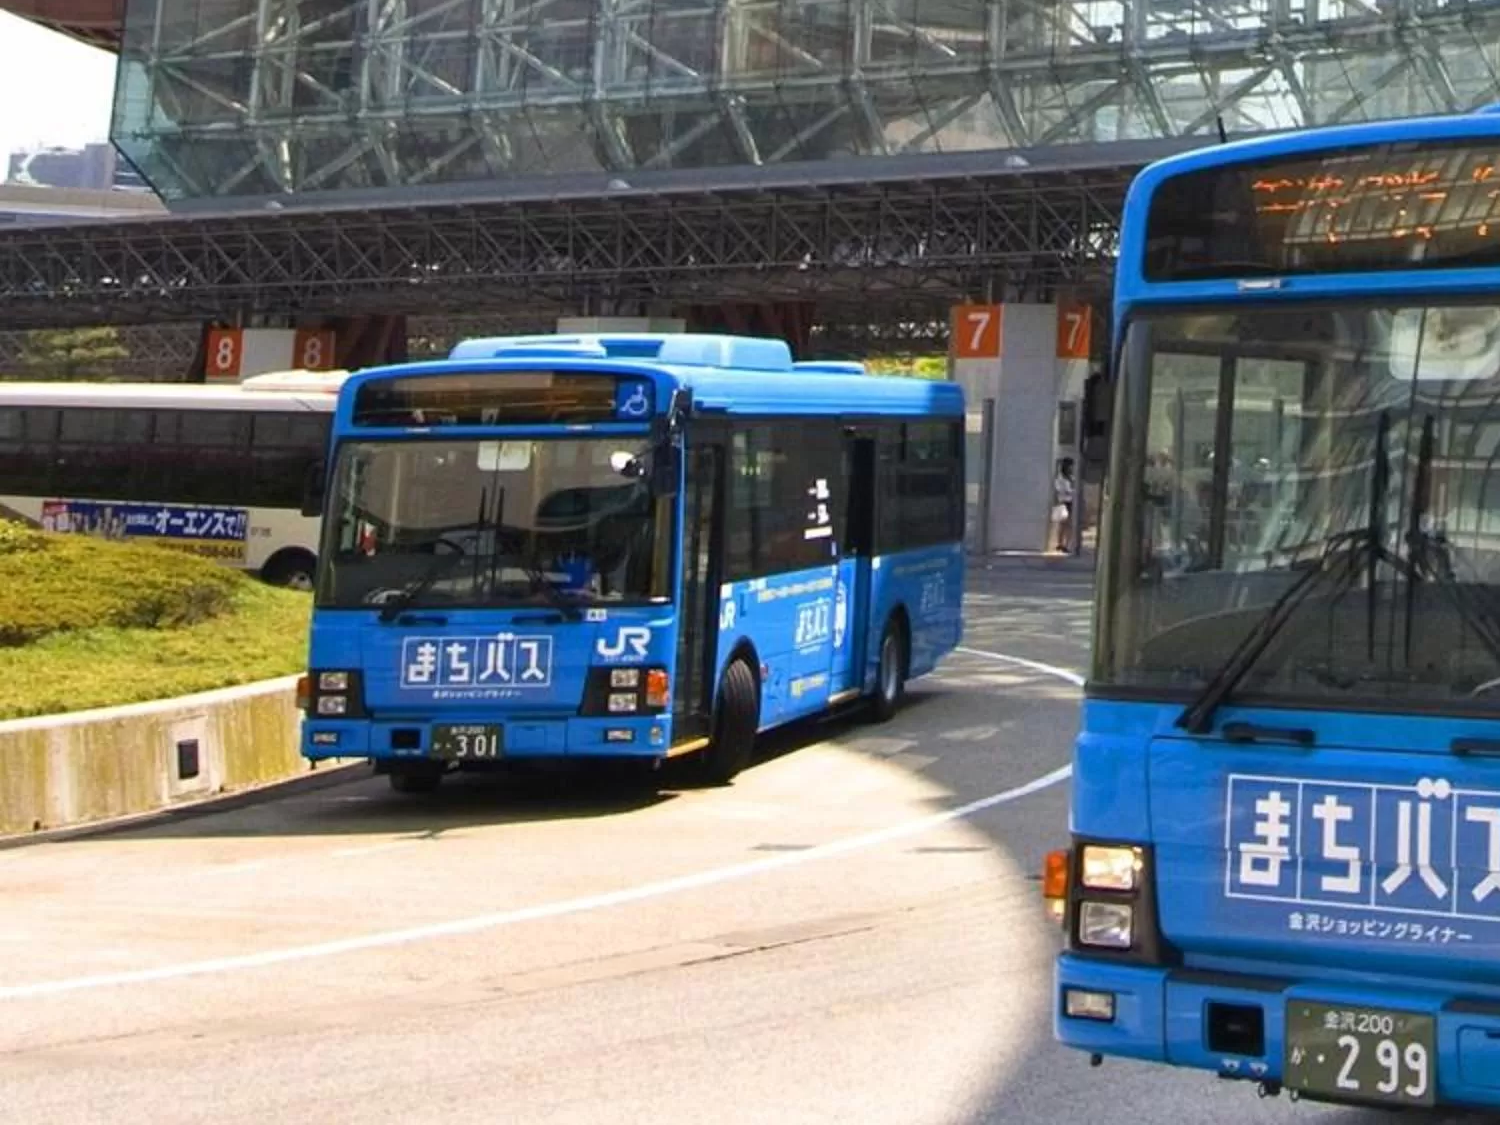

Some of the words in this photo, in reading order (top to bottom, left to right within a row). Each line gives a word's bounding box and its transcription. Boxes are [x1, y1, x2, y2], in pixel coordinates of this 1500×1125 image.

[967, 312, 991, 350] 7
[1065, 313, 1081, 350] 7
[216, 336, 234, 370] 8
[303, 336, 322, 368] 8
[407, 632, 545, 682] まちバス
[596, 627, 651, 657] JR
[455, 735, 497, 757] 301
[1288, 912, 1473, 944] 金沢ショッピングライナー
